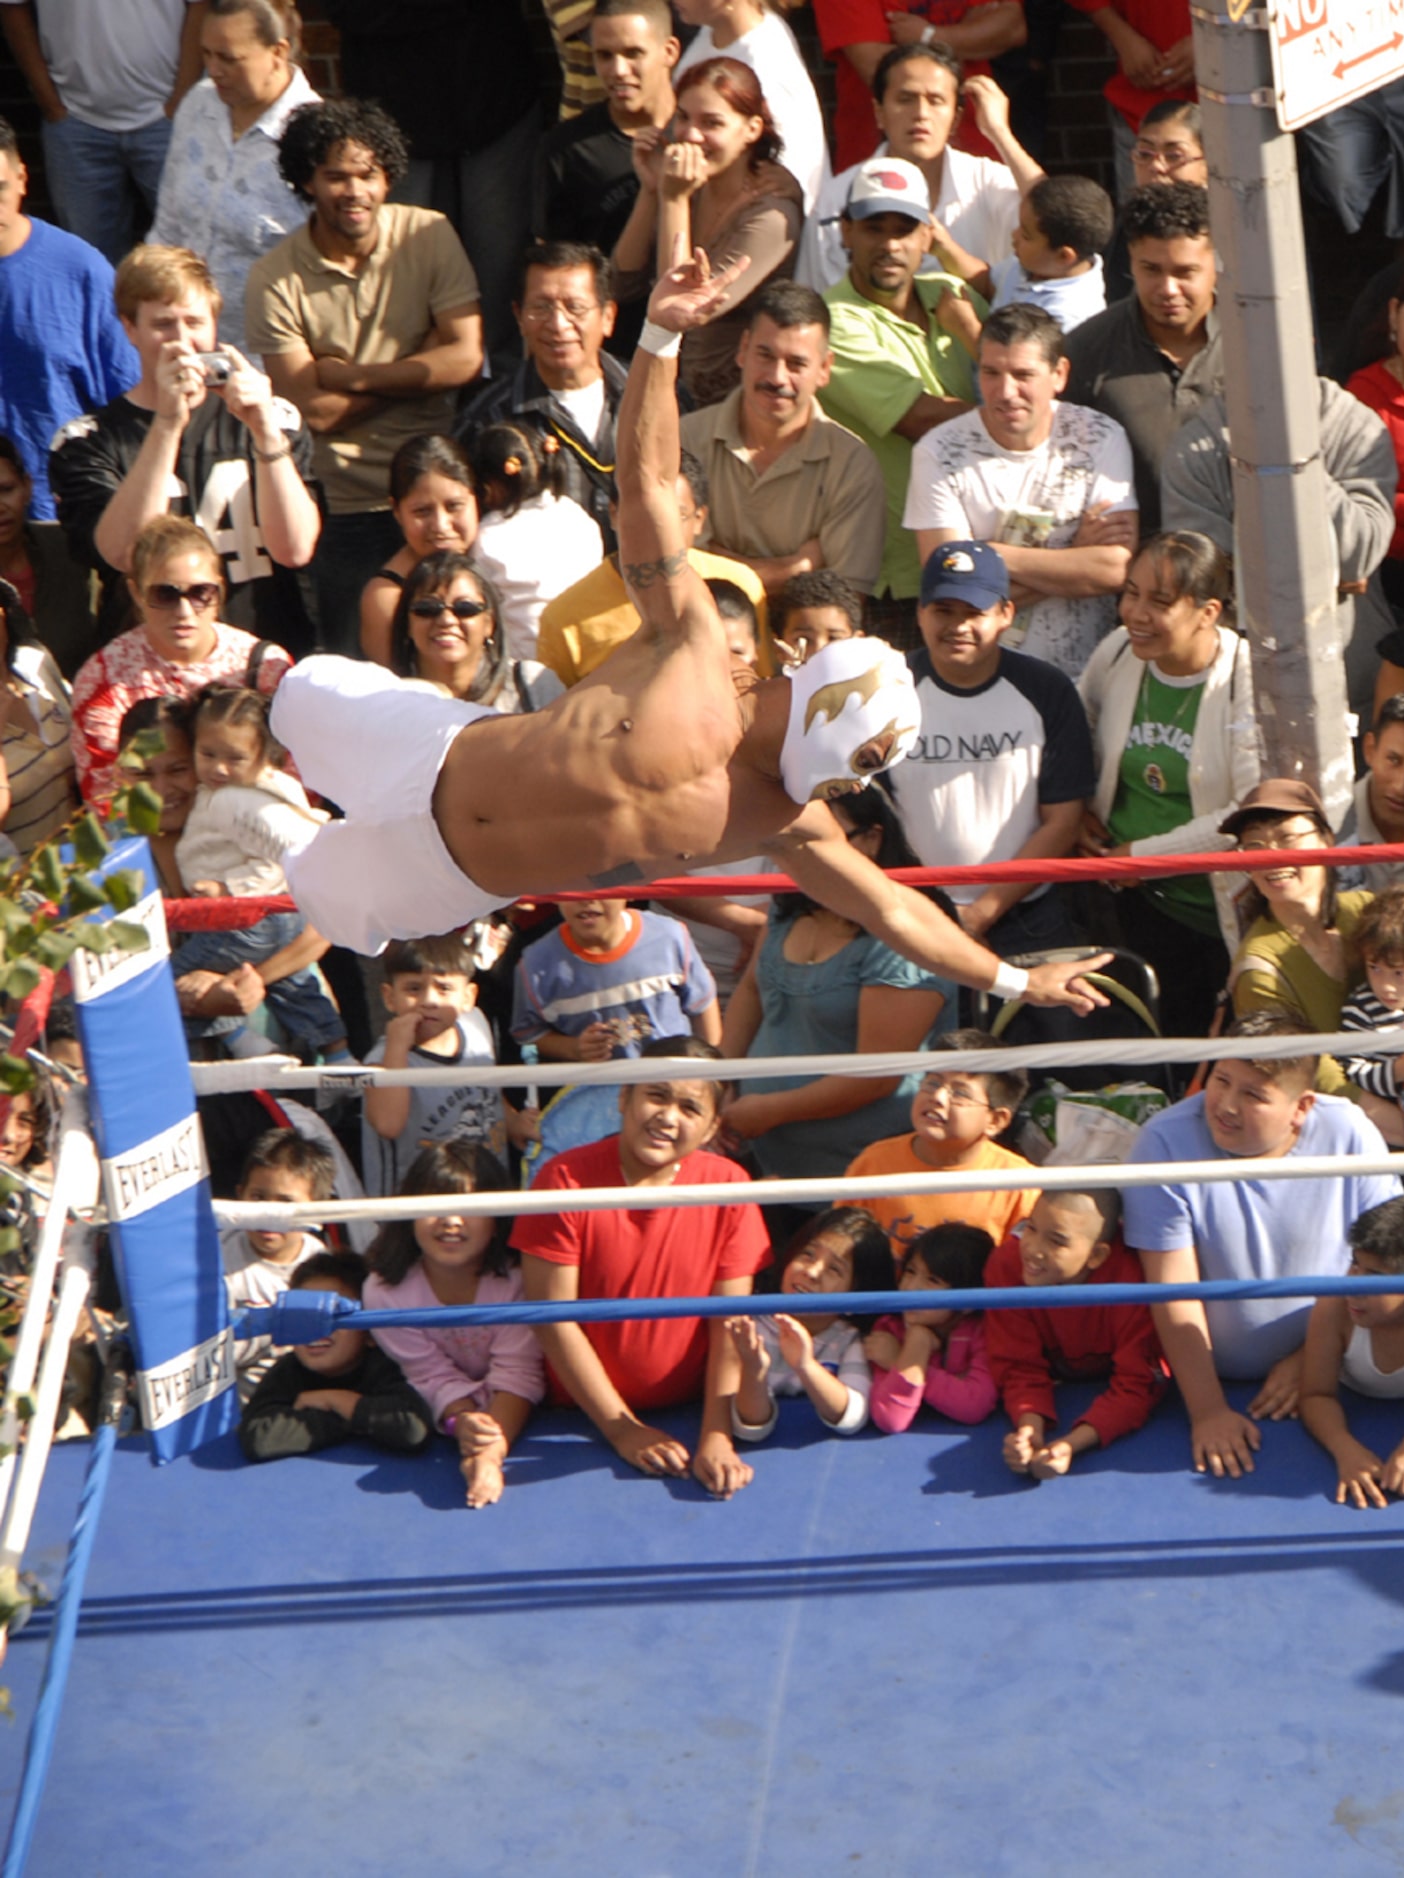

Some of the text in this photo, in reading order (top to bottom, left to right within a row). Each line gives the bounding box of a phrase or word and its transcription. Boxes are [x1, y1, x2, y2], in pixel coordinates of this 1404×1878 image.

[1276, 0, 1327, 38] NO
[906, 731, 1023, 760] OLD NAVY
[1127, 722, 1191, 761] MEXIC
[116, 1126, 200, 1209] EVERLAST
[150, 1338, 230, 1420] EVERLAST
